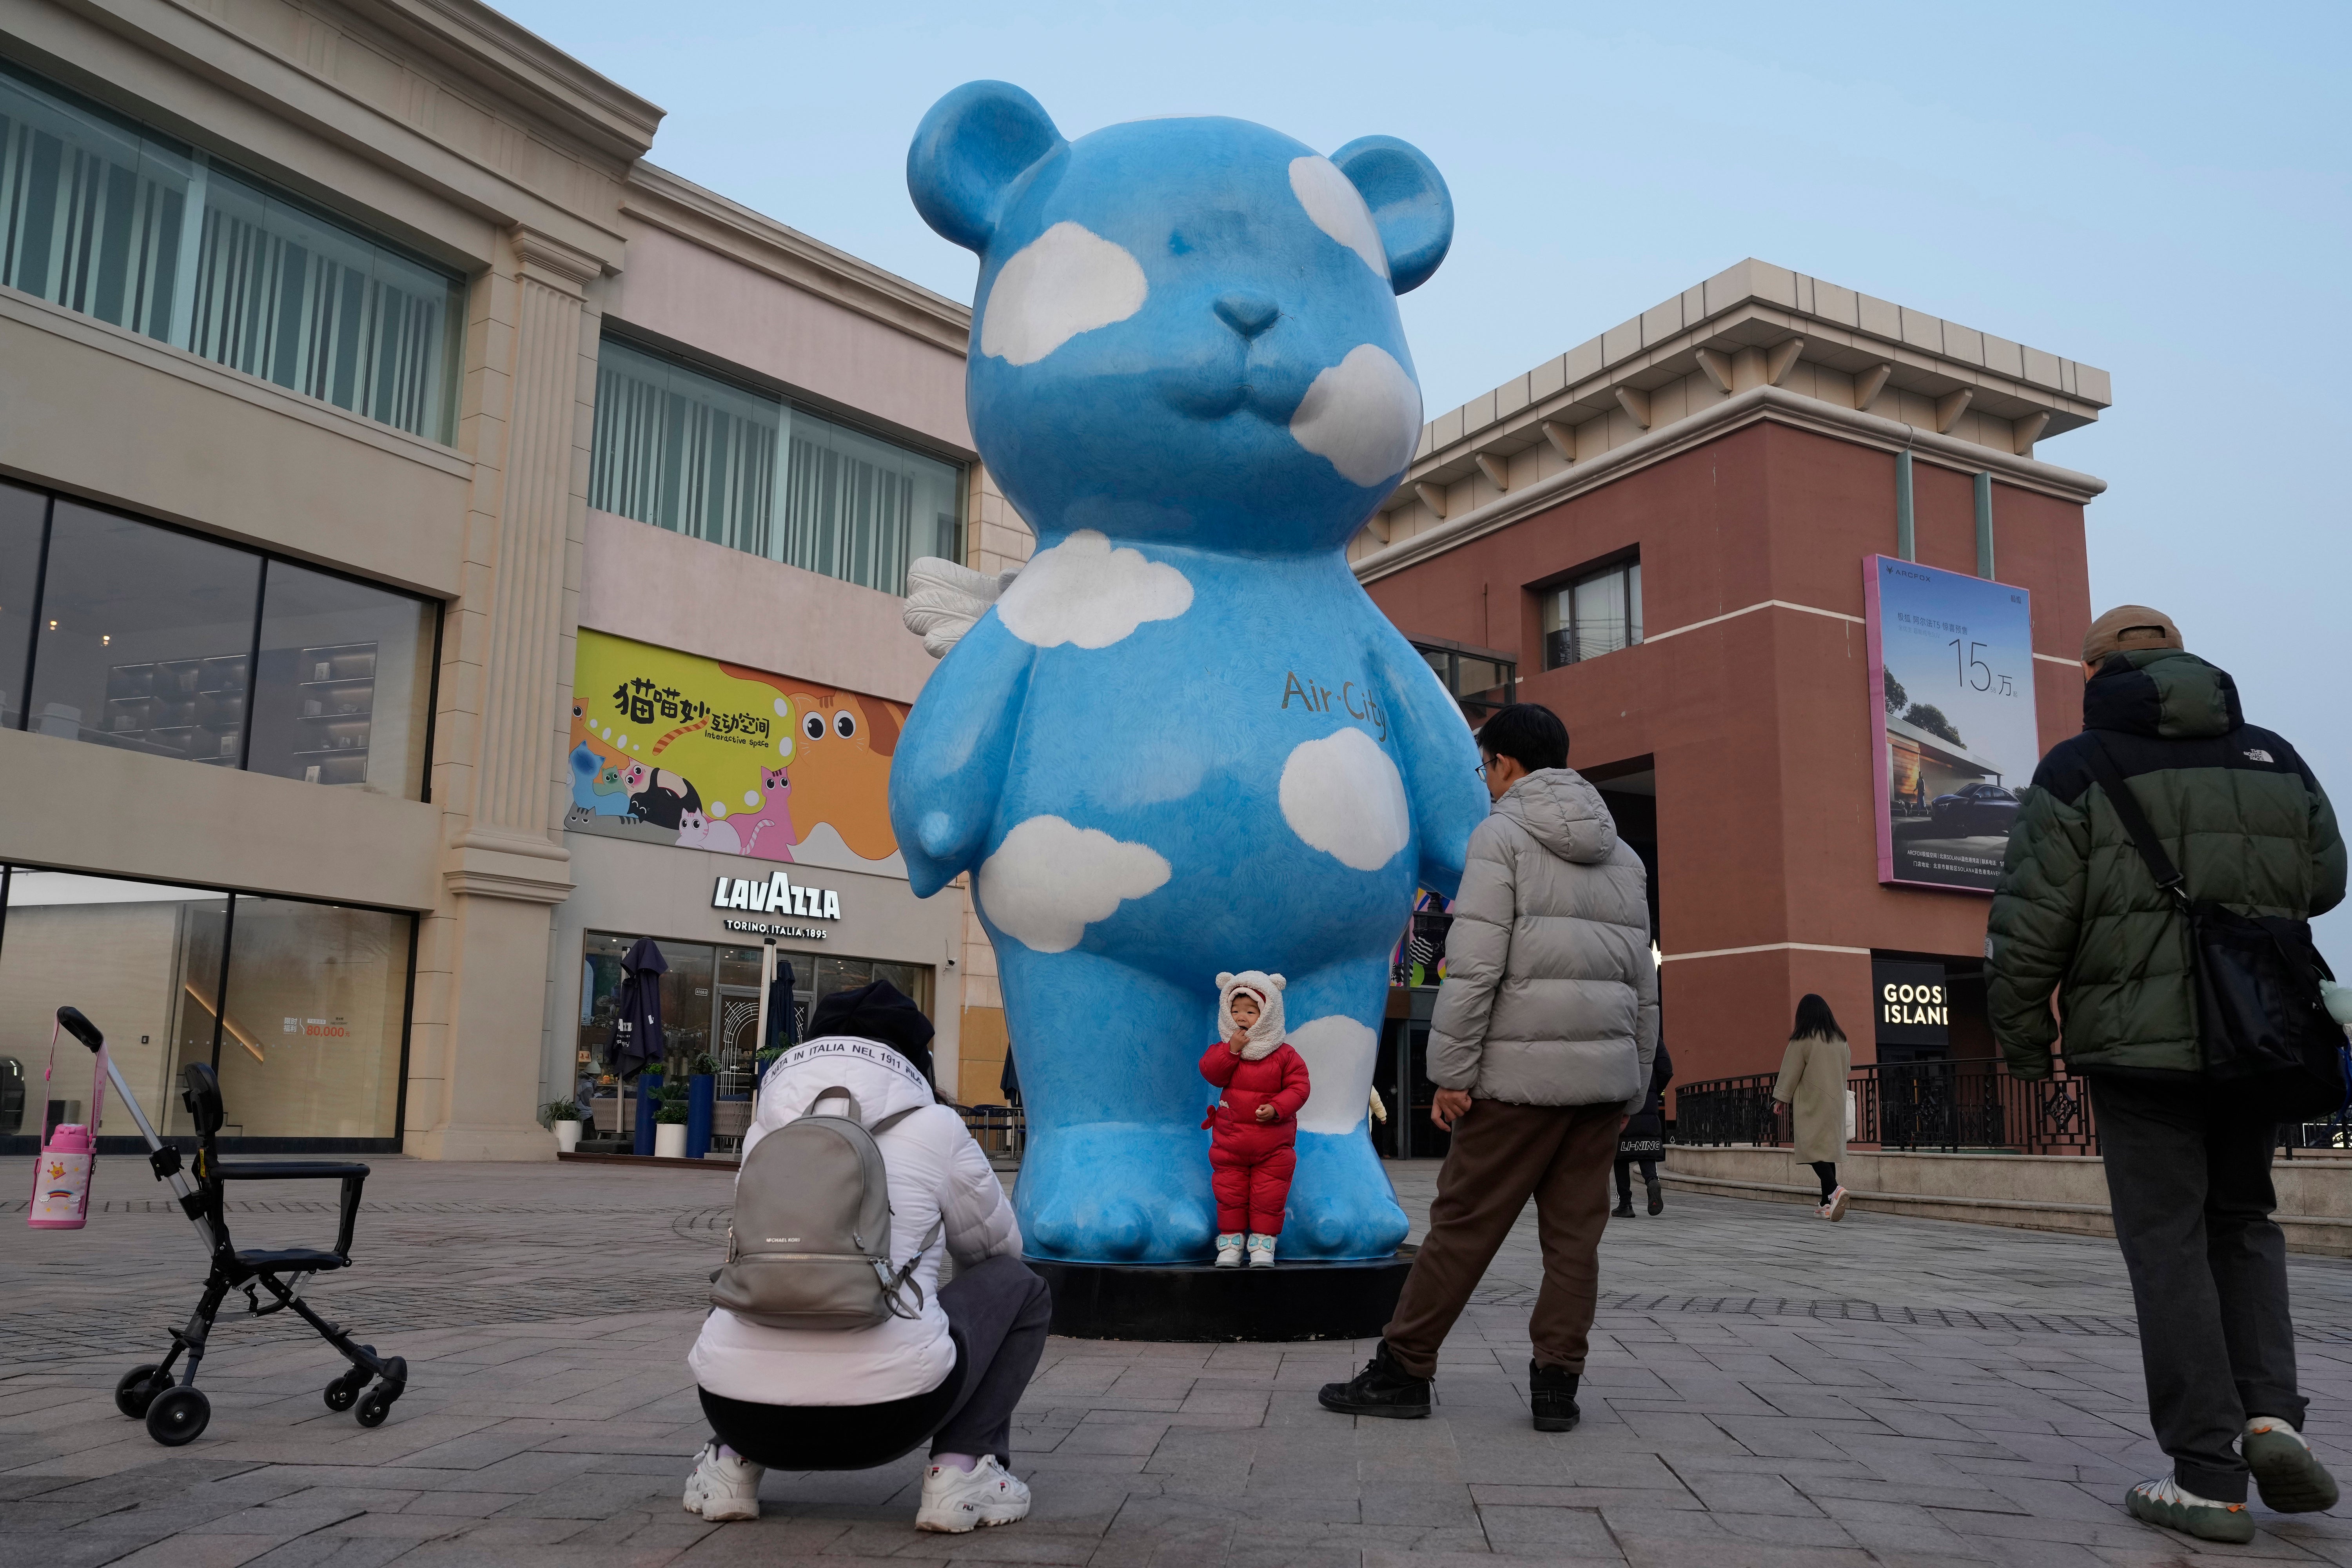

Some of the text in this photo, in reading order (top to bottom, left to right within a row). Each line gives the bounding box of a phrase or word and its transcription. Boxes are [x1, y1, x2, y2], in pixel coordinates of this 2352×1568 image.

[1896, 570, 1931, 582] ARCFOX
[1898, 612, 1967, 635] 极狐 阿尔法T5 惊喜预售
[705, 730, 769, 748] Interactive space
[712, 871, 841, 920] LAVAZZA
[1884, 984, 1947, 1004] GOOS
[283, 1024, 297, 1033] 福利
[771, 1057, 788, 1078] NATA
[794, 1050, 804, 1061] IN
[809, 1044, 845, 1056] ITALIA
[852, 1045, 875, 1058] NEL
[880, 1053, 900, 1069] 1911
[906, 1065, 922, 1085] FILA
[1621, 1141, 1660, 1151] LI-NING
